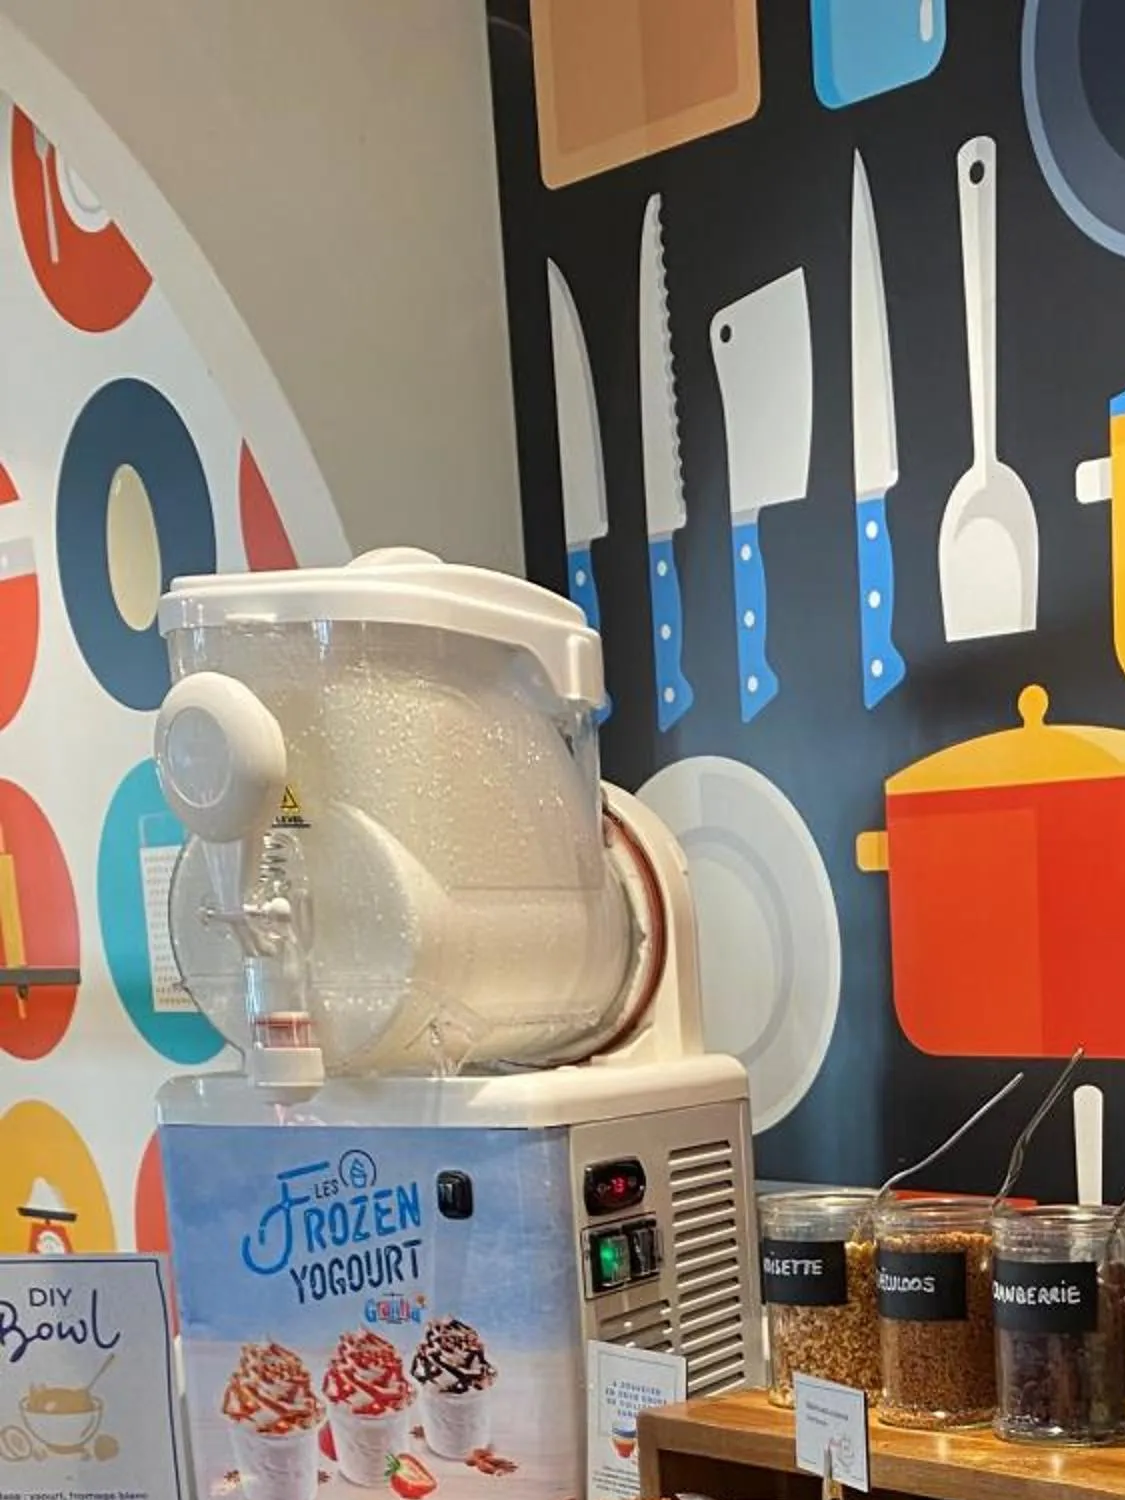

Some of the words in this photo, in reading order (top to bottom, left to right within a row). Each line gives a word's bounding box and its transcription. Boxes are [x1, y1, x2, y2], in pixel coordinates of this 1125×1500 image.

[242, 1160, 421, 1276] FROZEN
[314, 1179, 339, 1199] LES
[29, 1287, 73, 1307] DIY
[289, 1239, 422, 1304] YOGOURT
[0, 1289, 121, 1363] Bowl
